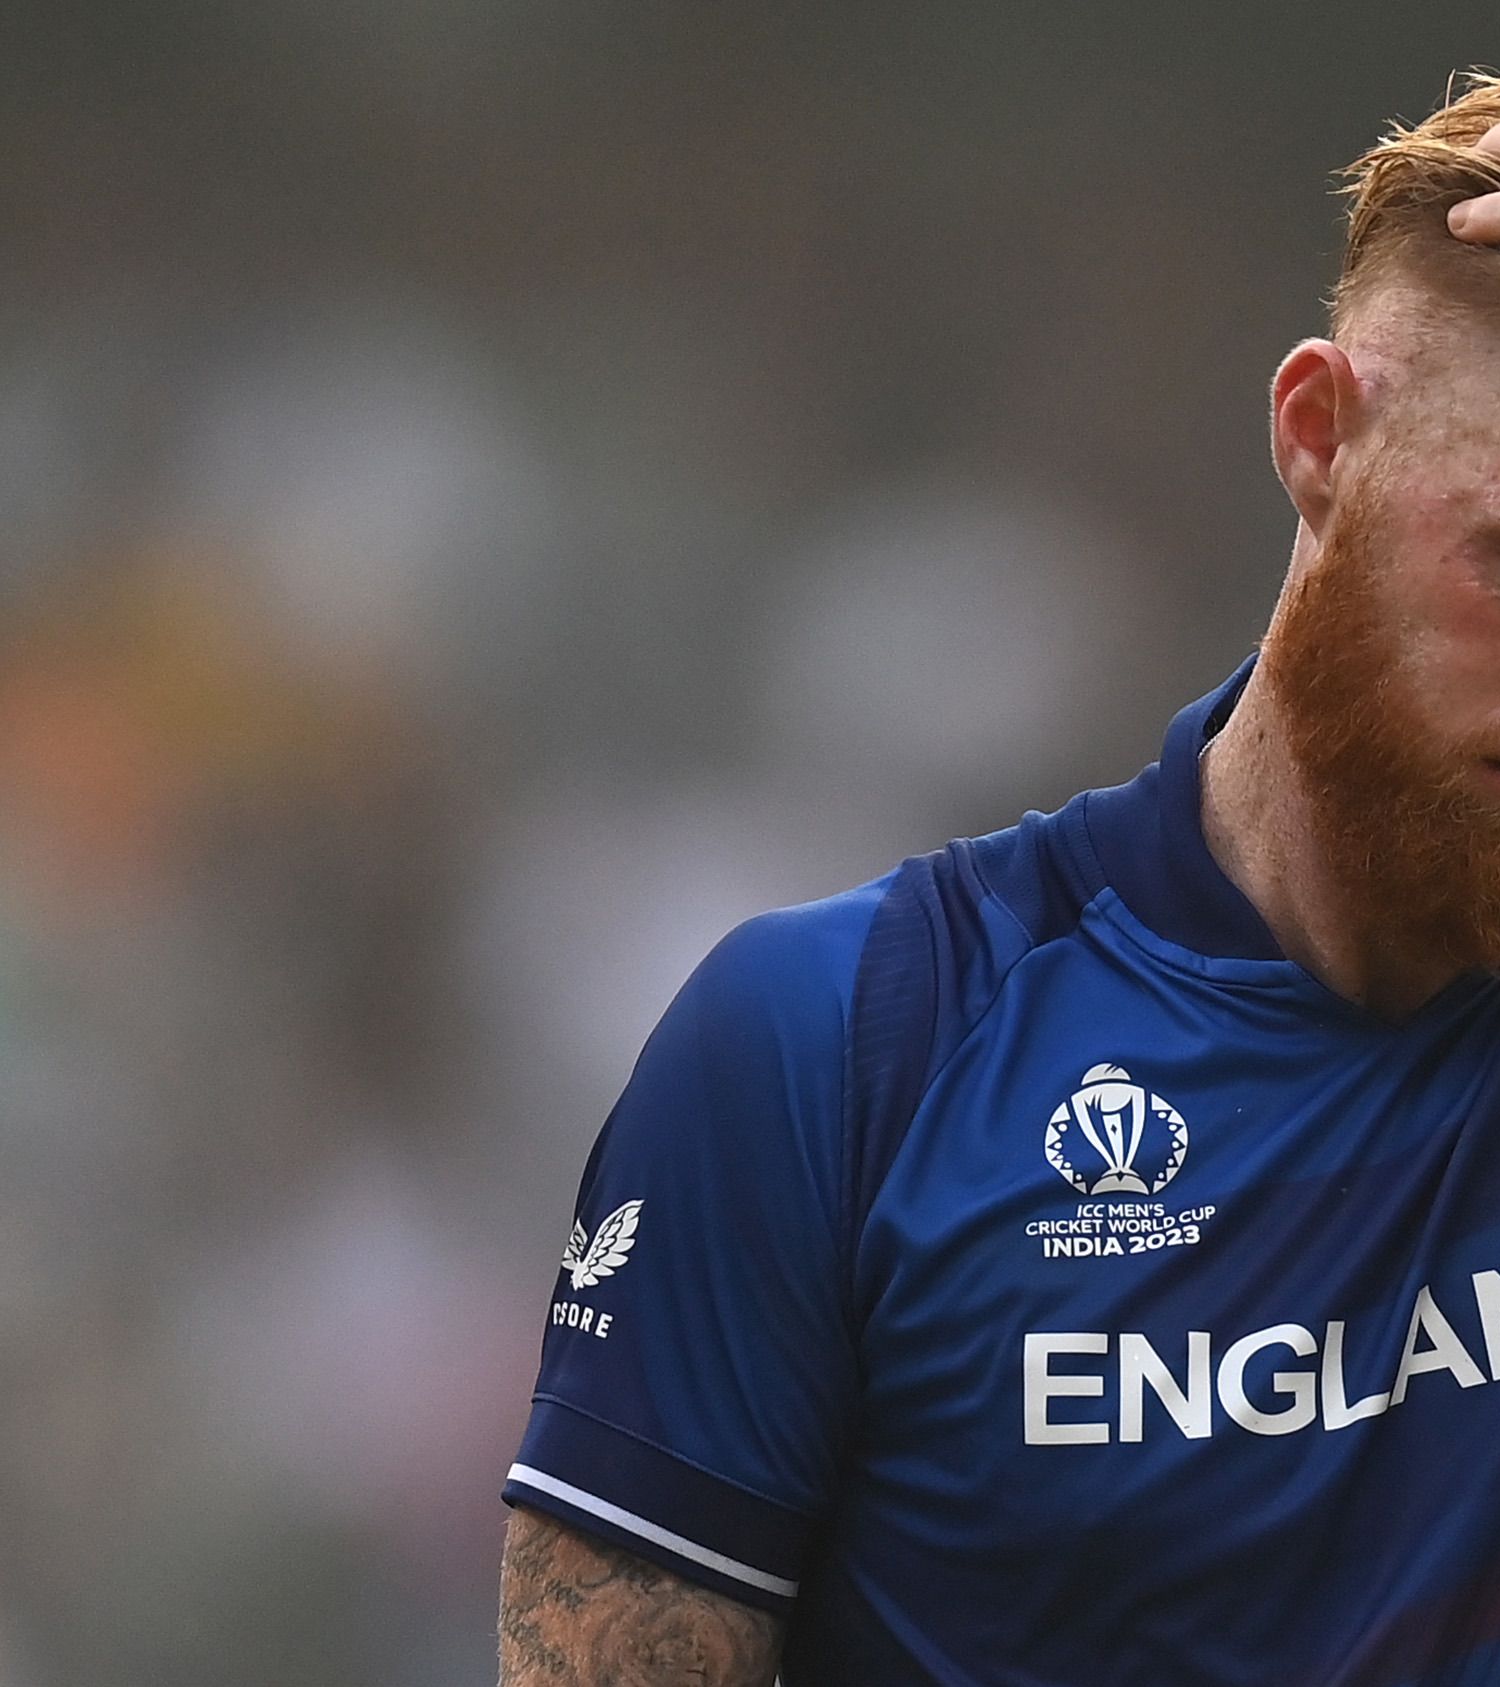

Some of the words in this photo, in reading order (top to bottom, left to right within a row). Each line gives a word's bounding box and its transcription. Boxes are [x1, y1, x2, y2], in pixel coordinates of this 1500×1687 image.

[1025, 1219, 1104, 1236] CRICKET
[1107, 1216, 1175, 1233] WORLD
[1178, 1205, 1216, 1223] CUP
[1076, 1204, 1105, 1218] ICC
[1108, 1203, 1165, 1218] MEN'S
[1043, 1236, 1125, 1258] INDIA
[1128, 1224, 1201, 1254] 2023
